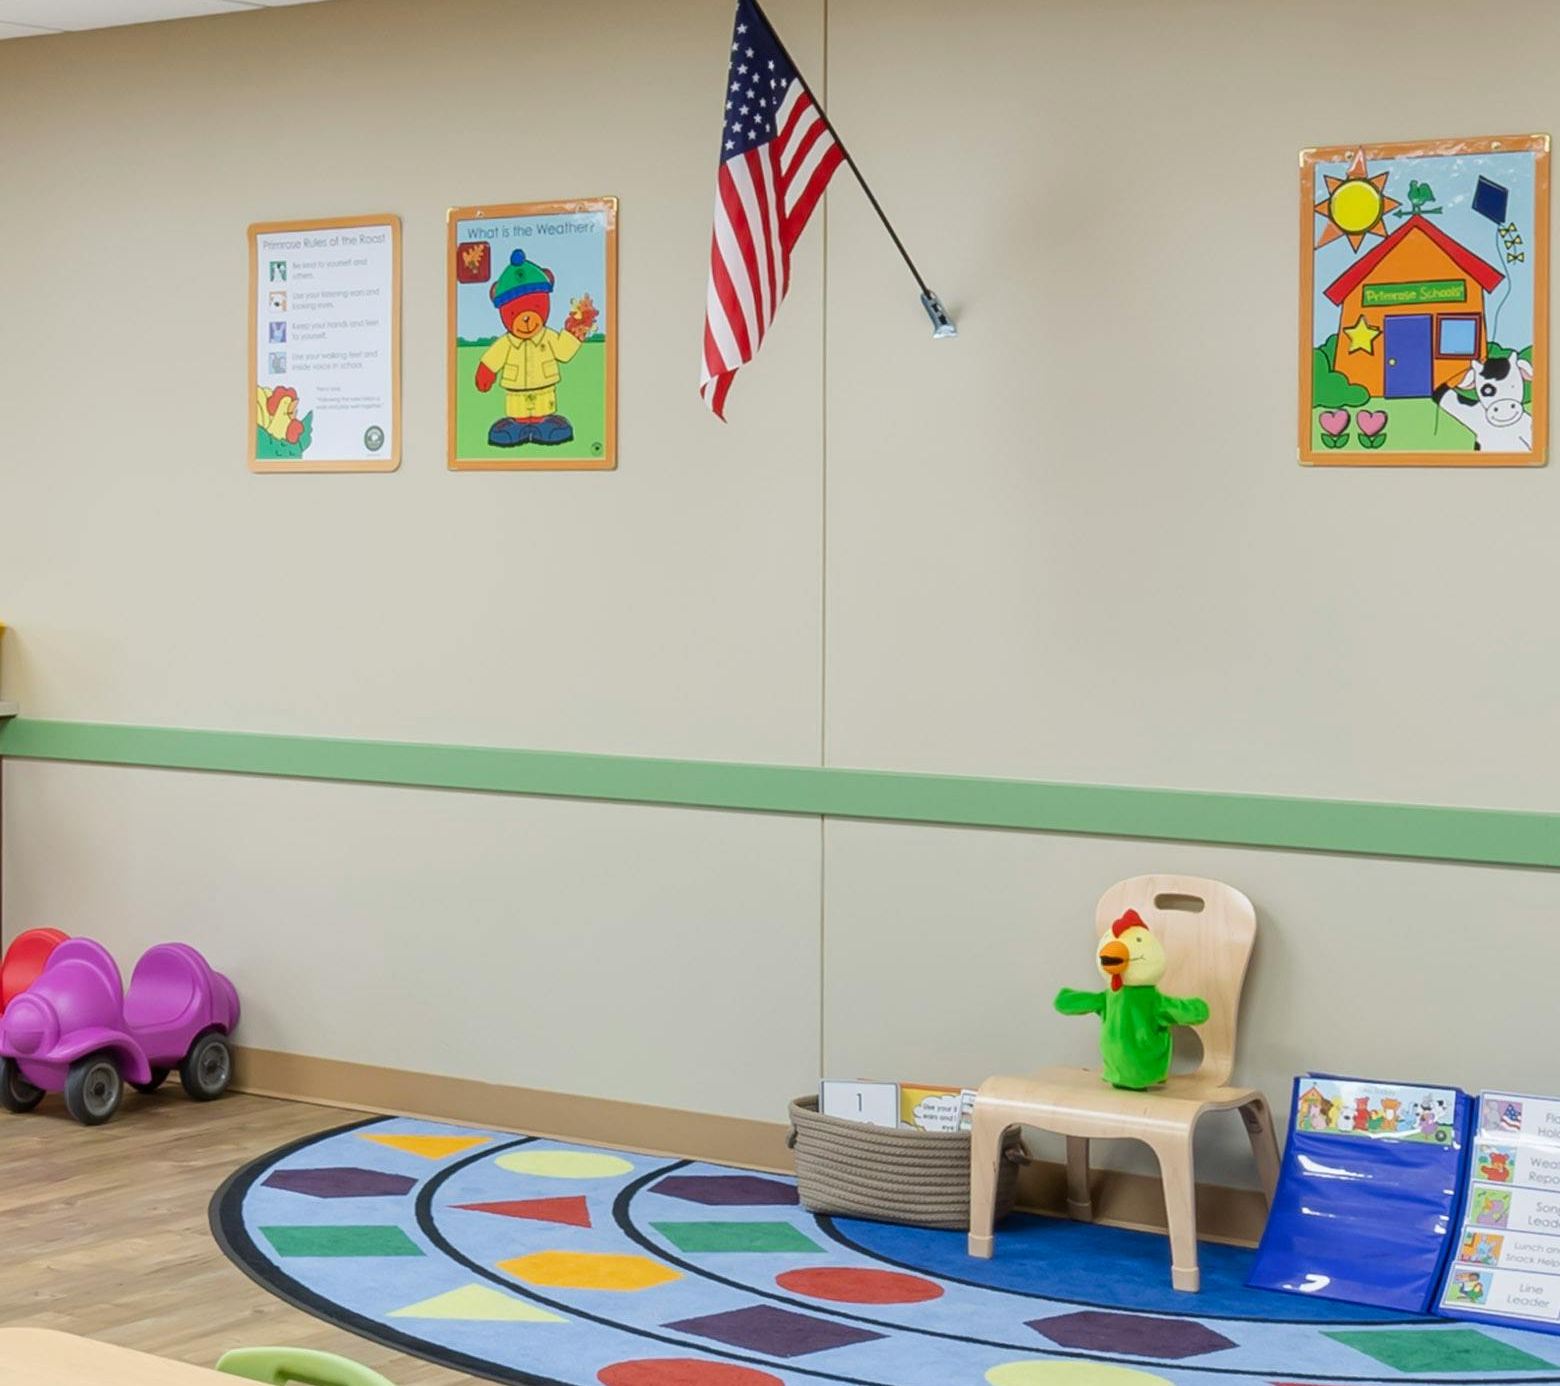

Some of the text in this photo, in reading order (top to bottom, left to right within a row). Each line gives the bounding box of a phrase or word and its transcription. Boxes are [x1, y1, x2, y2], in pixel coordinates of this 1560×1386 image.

[468, 221, 595, 239] What is the Weather?
[263, 233, 385, 250] Primrose Rules of the Roost
[1366, 290, 1416, 301] Primrose
[856, 1092, 863, 1112] 1
[1514, 1242, 1544, 1254] Lunch
[1505, 1253, 1534, 1264] Snack
[1519, 1283, 1544, 1295] Line
[1507, 1294, 1550, 1309] Leader
